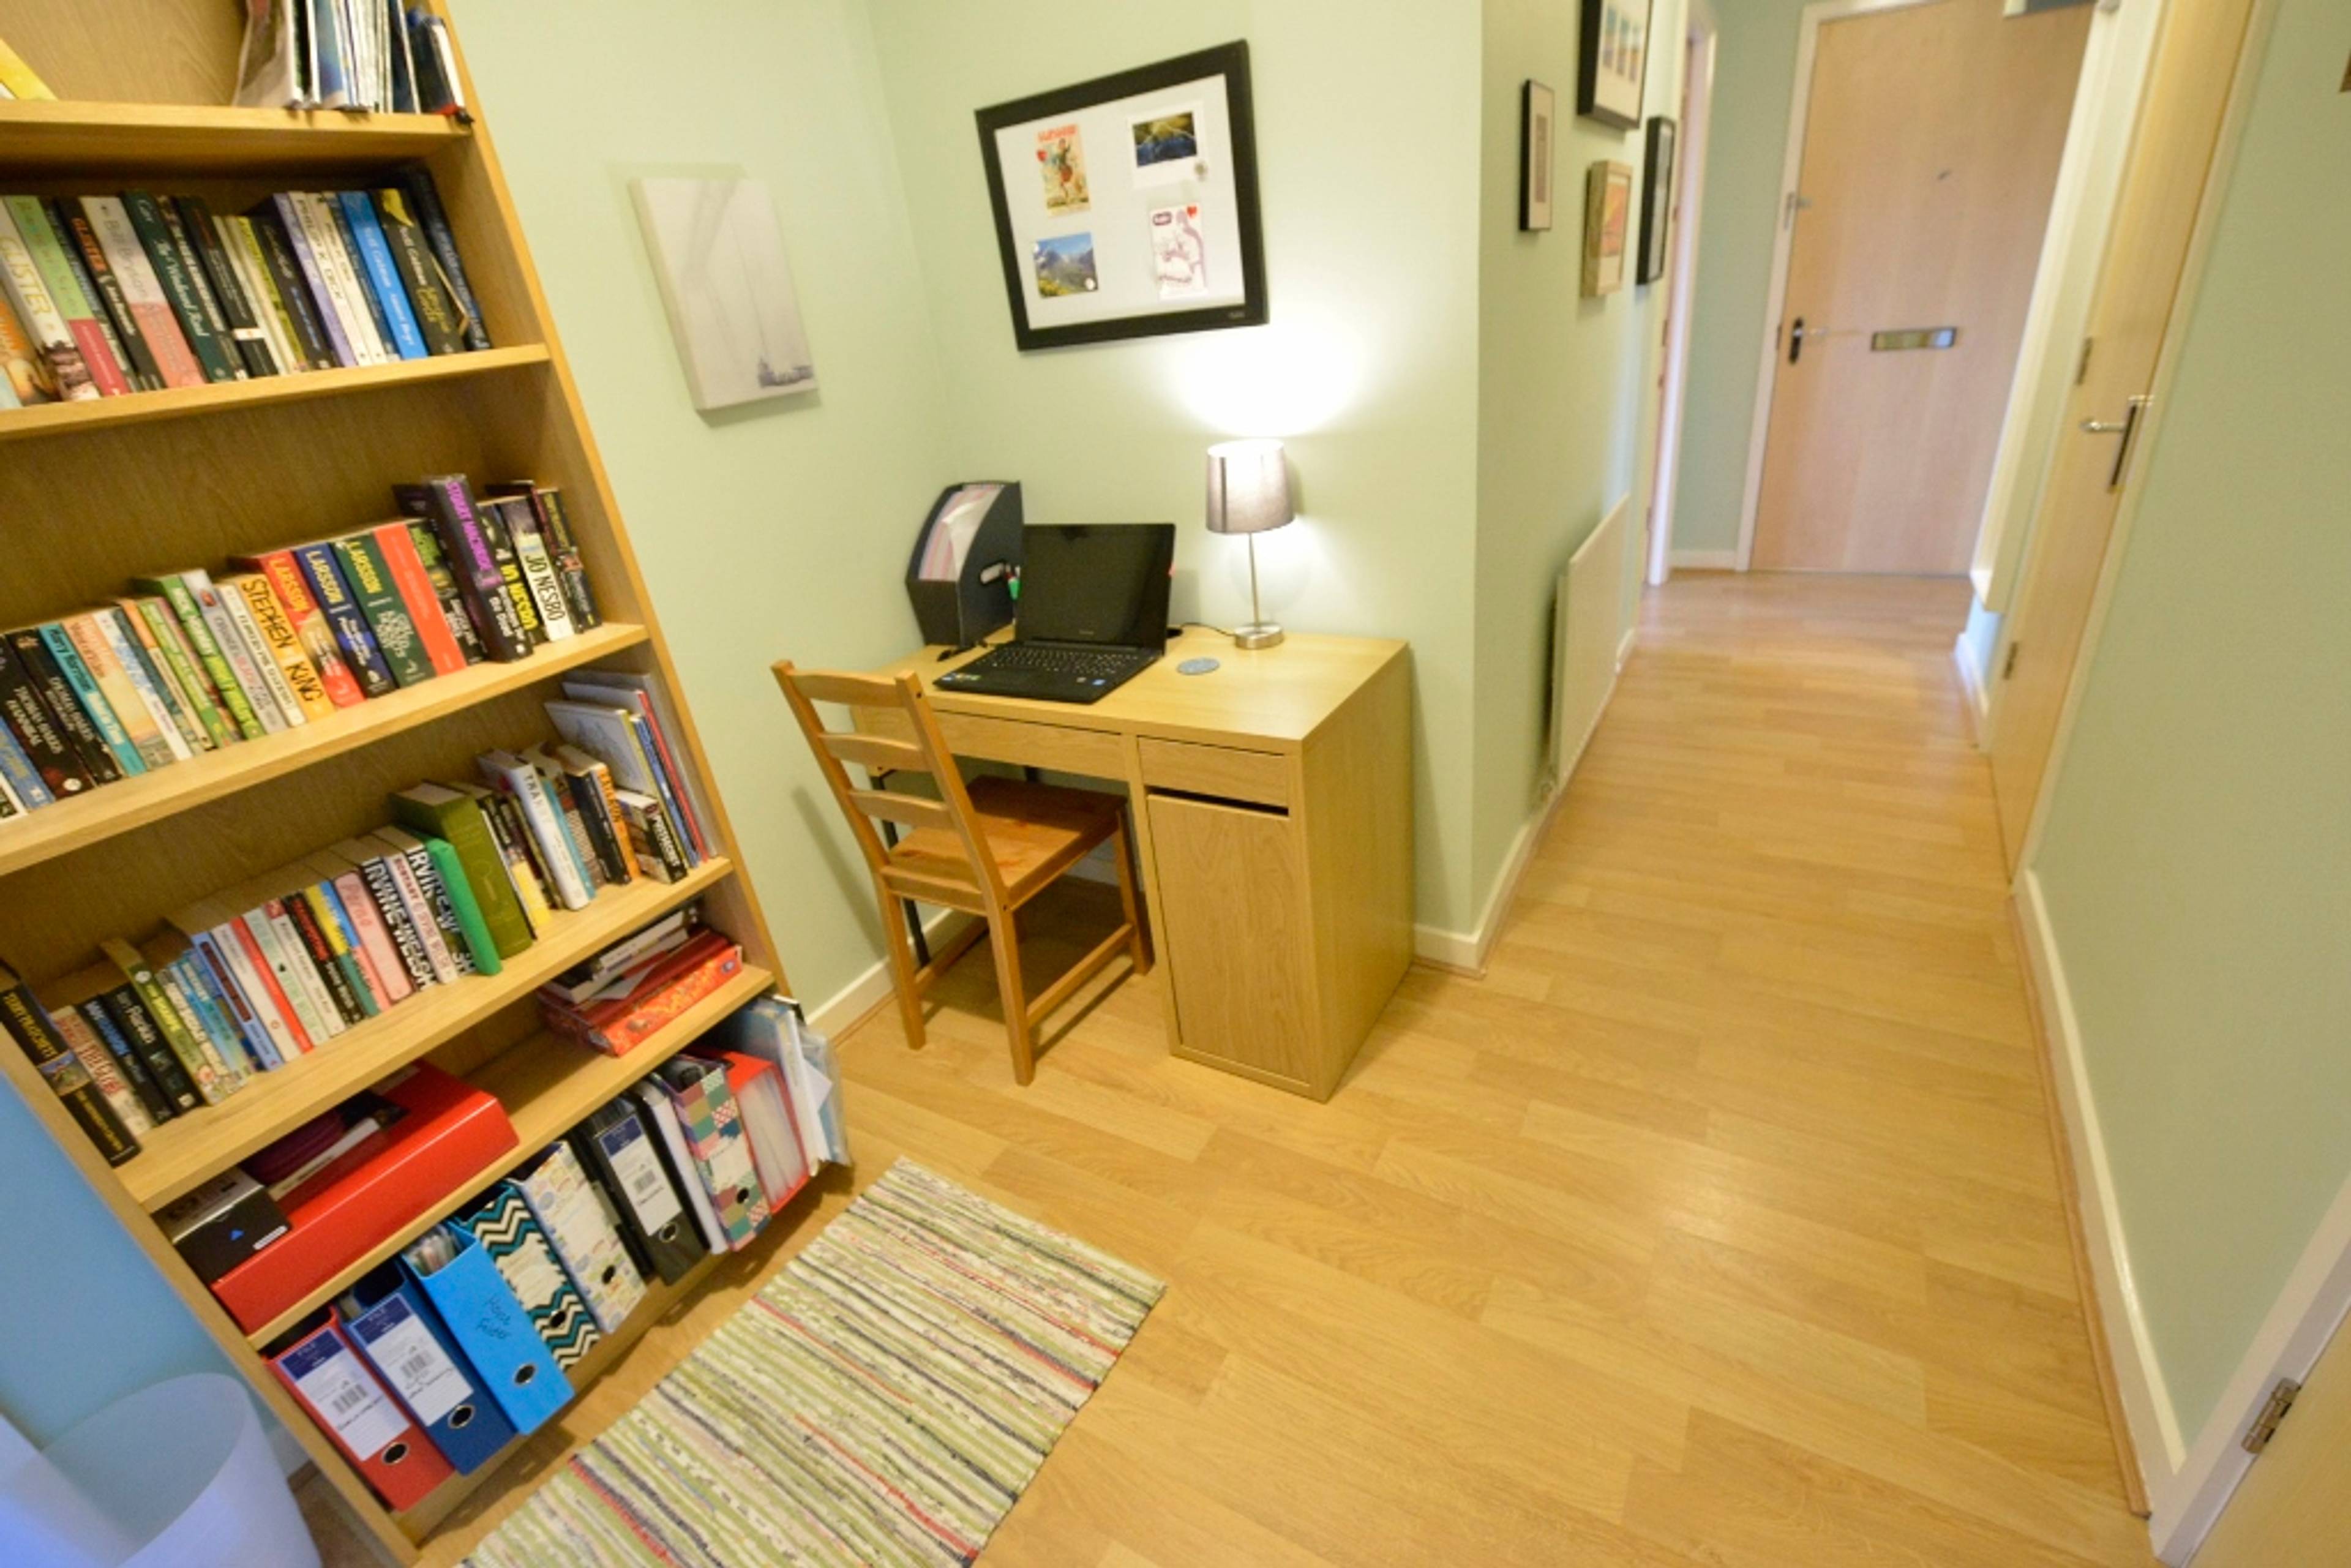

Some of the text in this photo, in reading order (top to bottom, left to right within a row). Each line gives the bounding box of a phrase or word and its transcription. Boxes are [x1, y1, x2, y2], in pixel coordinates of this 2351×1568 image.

[269, 558, 310, 612] LARSSON
[306, 551, 345, 604] LARSSON
[347, 541, 382, 593] LARSSON
[526, 557, 547, 572] JO
[241, 579, 324, 701] STEPHEN KING
[361, 857, 437, 991] IRVINE WELSH
